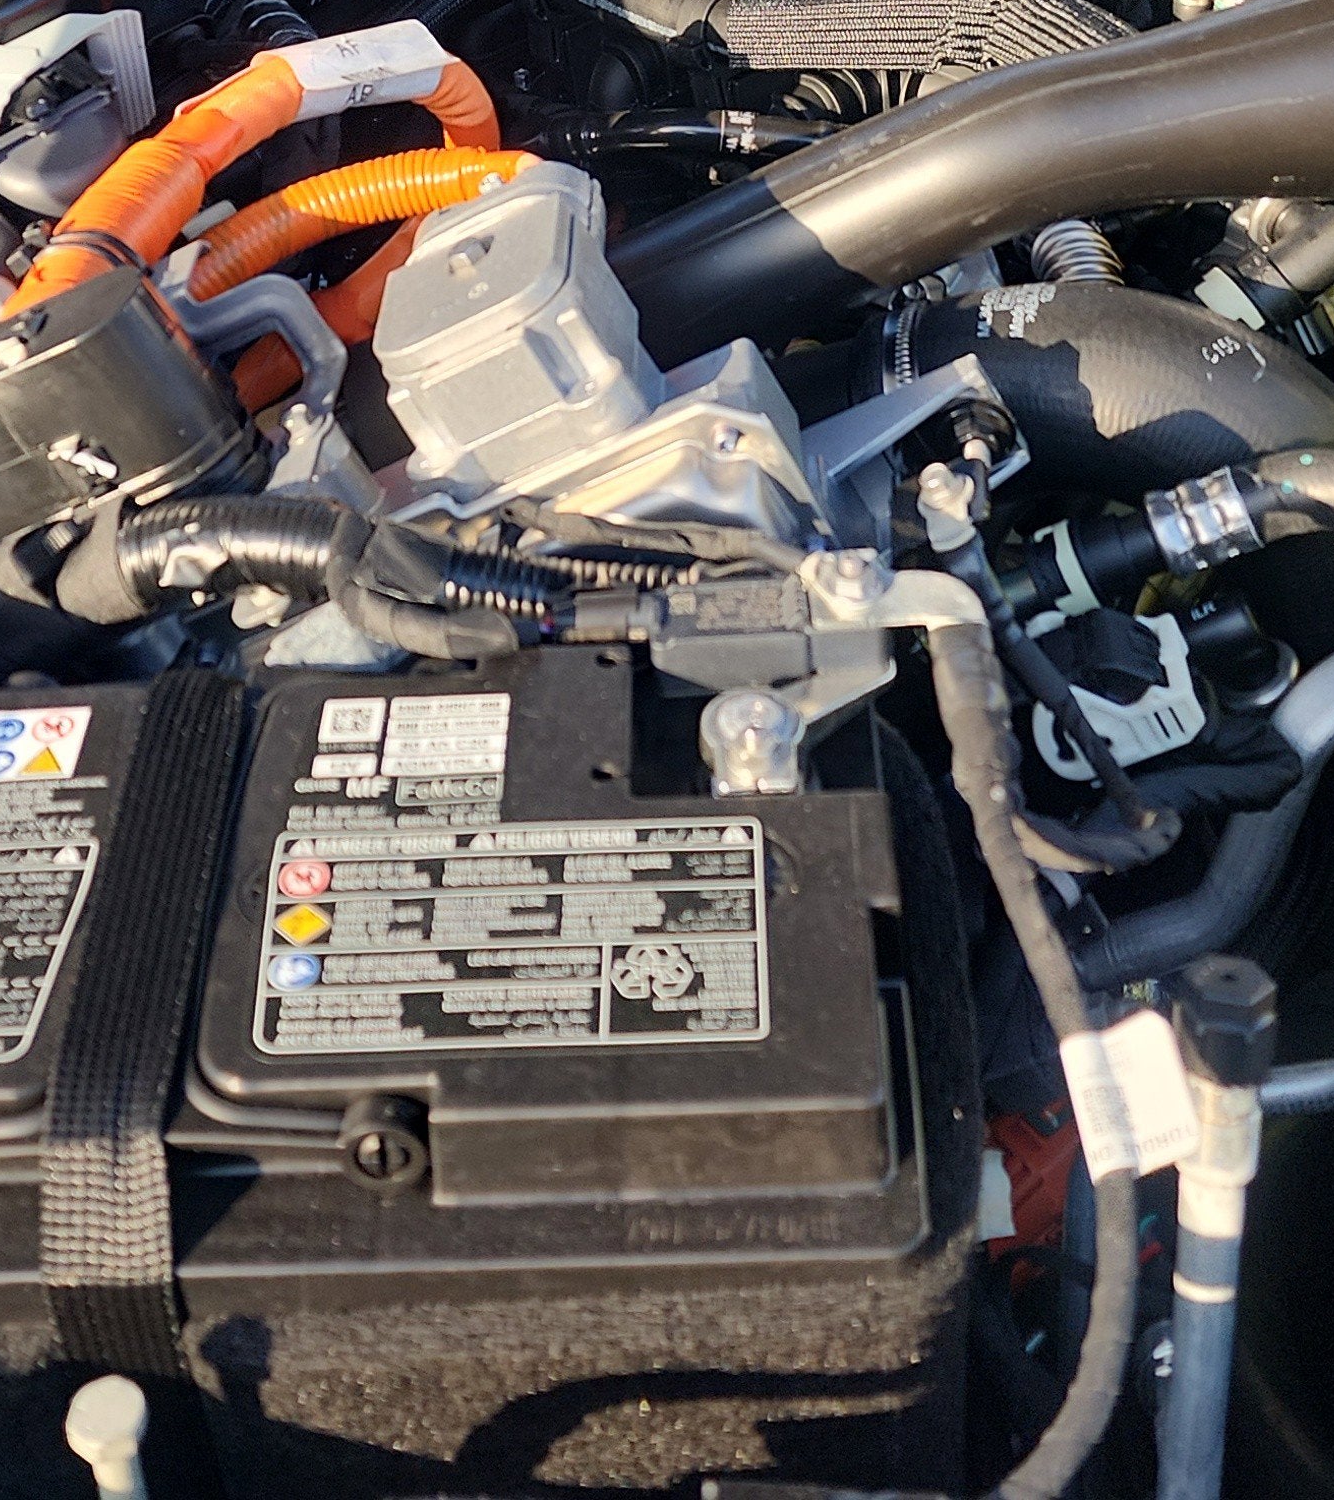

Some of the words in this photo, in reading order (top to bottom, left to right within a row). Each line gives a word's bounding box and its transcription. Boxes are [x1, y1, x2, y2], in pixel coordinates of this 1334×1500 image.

[345, 776, 392, 798] MF
[399, 779, 498, 800] FoMoCo
[494, 830, 568, 850] PELIGRO
[568, 828, 637, 848] VENENO
